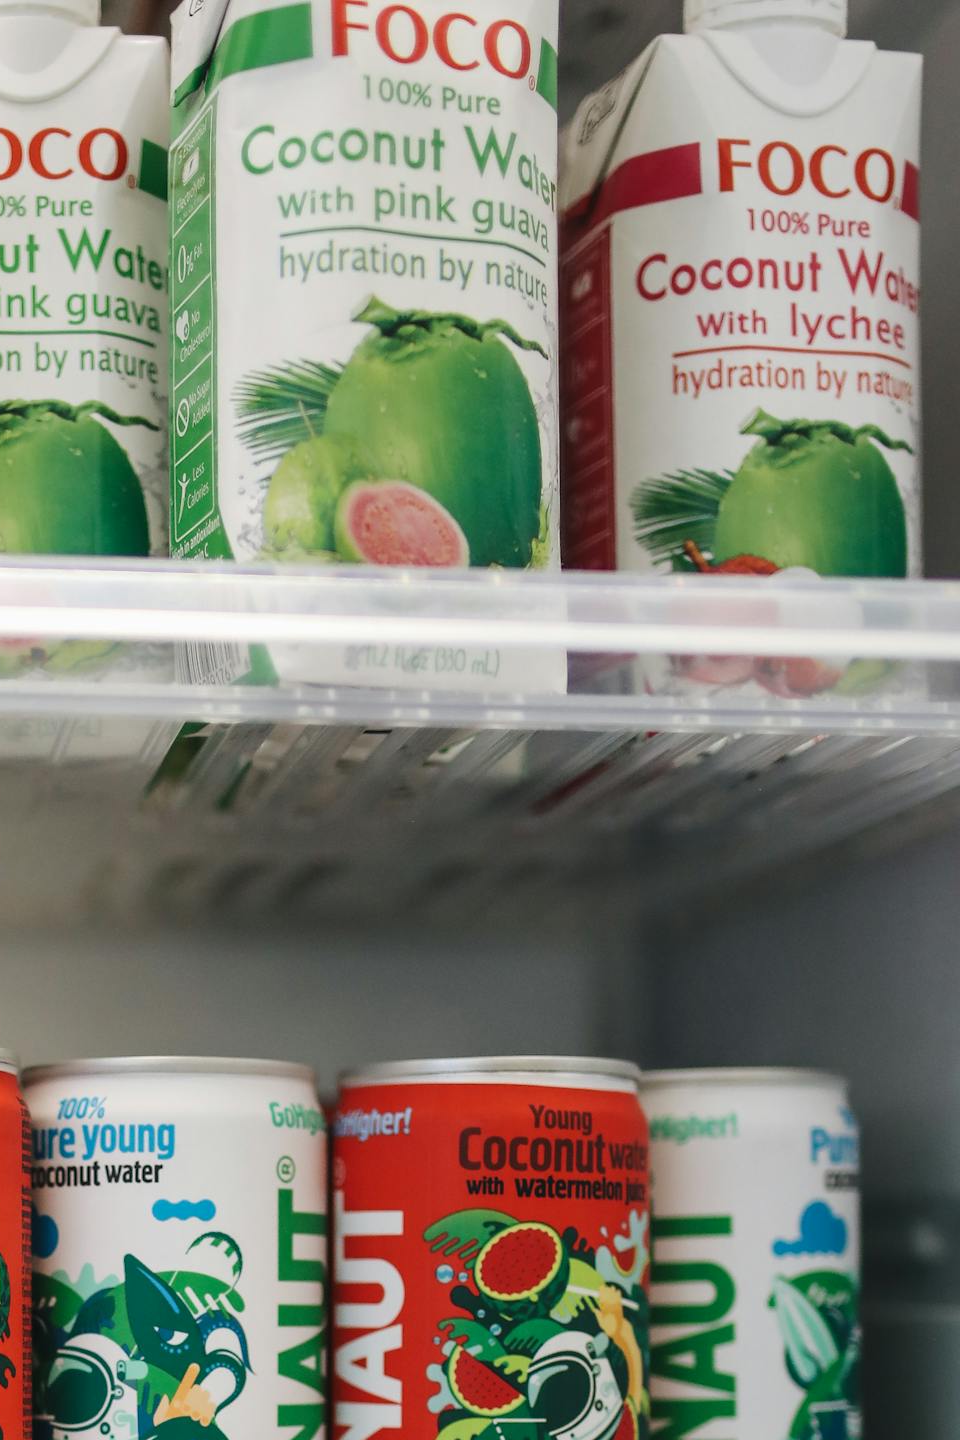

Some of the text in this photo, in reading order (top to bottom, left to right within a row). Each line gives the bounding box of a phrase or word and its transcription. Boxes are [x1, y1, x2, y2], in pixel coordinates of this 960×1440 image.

[331, 0, 532, 80] FOCO
[363, 74, 501, 115] 100% Pure
[240, 124, 445, 175] Coconut
[464, 126, 556, 213] Water
[717, 138, 897, 203] FOCO
[35, 196, 94, 217] Pure
[277, 184, 549, 253] with pink guava
[747, 209, 871, 238] 100% Pure
[279, 240, 548, 308] hydration by nature
[636, 252, 821, 301] Coconut
[65, 292, 162, 334] guava
[696, 303, 906, 350] with lychee
[34, 343, 69, 378] by
[80, 350, 159, 384] nature
[672, 358, 806, 398] hydration
[817, 361, 847, 398] by
[57, 1096, 107, 1120] 100%
[529, 1105, 592, 1135] Young
[31, 1123, 175, 1161] ure young
[459, 1127, 606, 1174] Coconut
[105, 1161, 163, 1184] water
[466, 1174, 623, 1201] with watermelon
